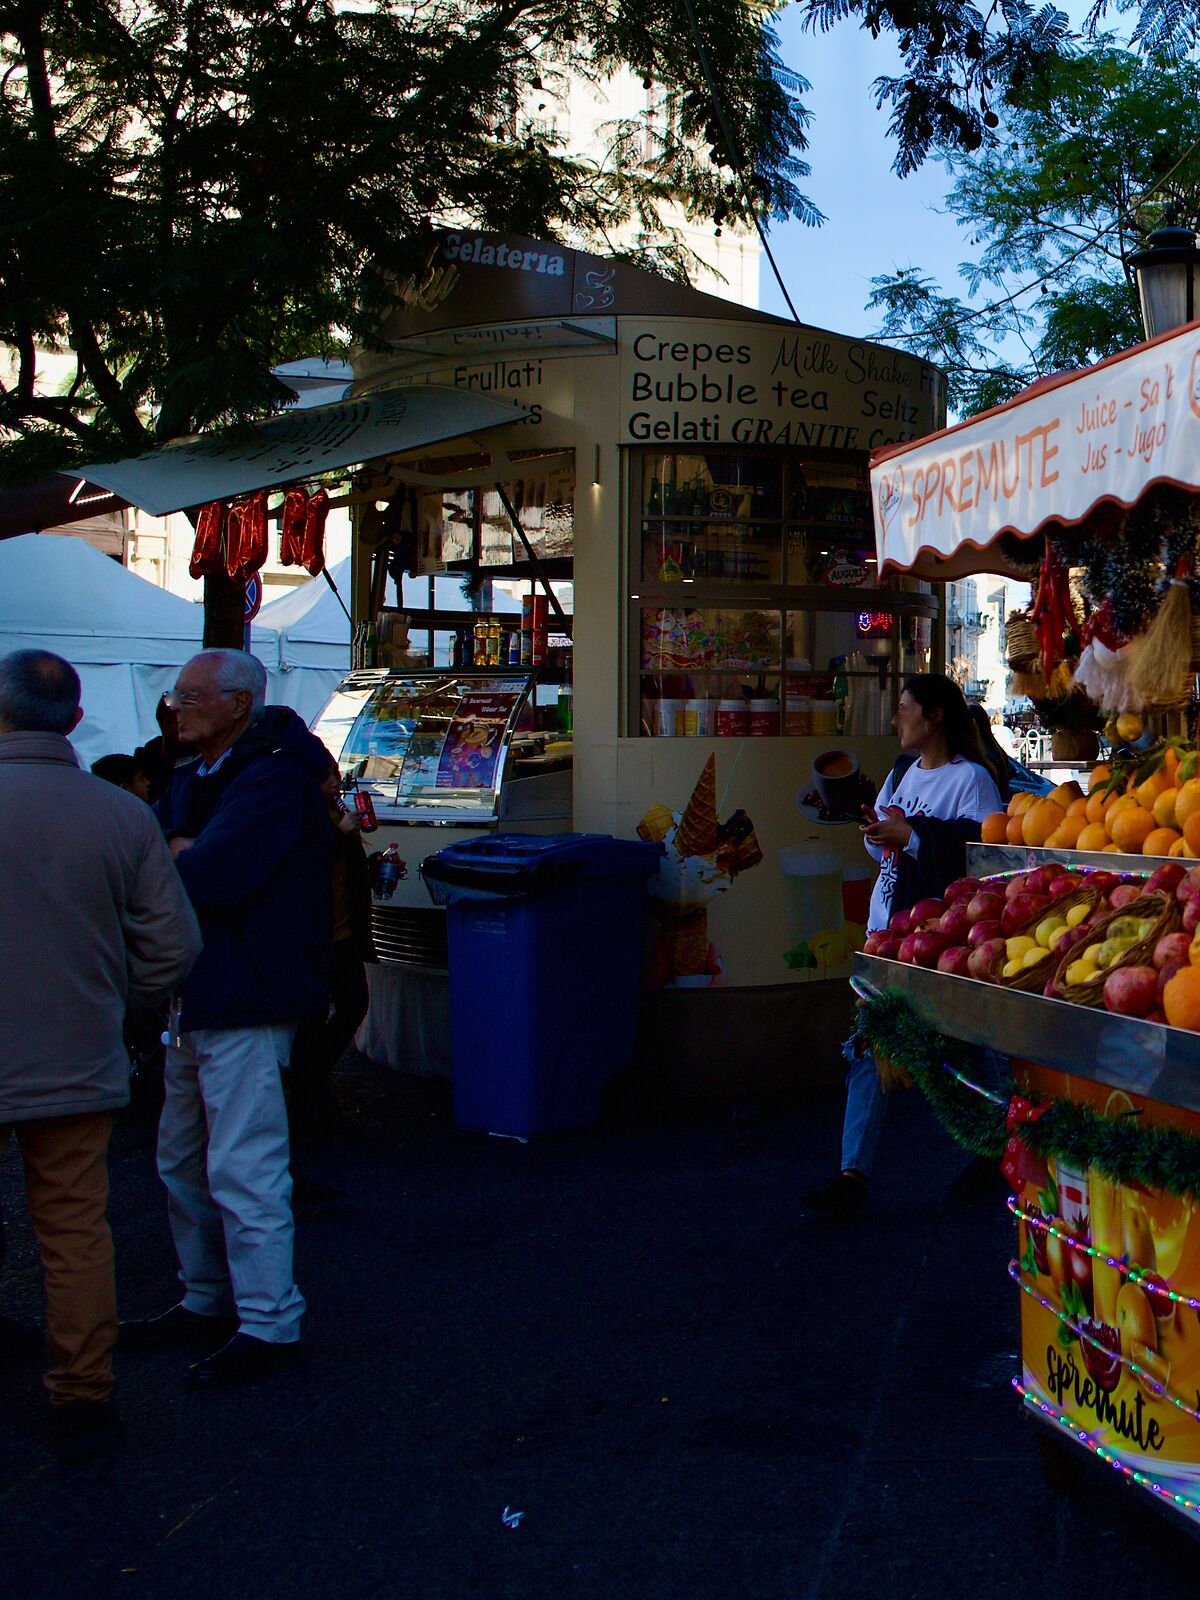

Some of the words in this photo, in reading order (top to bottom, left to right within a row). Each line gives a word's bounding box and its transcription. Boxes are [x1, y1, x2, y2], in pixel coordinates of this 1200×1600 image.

[443, 234, 566, 277] Gelateria
[454, 360, 543, 391] Frullati
[633, 333, 752, 371] Crepes
[771, 336, 840, 380] Milk
[845, 344, 913, 389] Shake
[632, 372, 758, 405] Bubble
[771, 381, 830, 412] tea
[861, 390, 919, 425] Seltz
[1077, 393, 1117, 434] Juice
[1140, 363, 1175, 412] Sat
[628, 411, 720, 442] Gelati
[731, 417, 859, 450] GRANITE
[1081, 442, 1108, 474] Jus
[1127, 421, 1167, 464] Jugo
[908, 417, 1061, 529] SPREMUTE
[1046, 1344, 1166, 1452] Spremute
